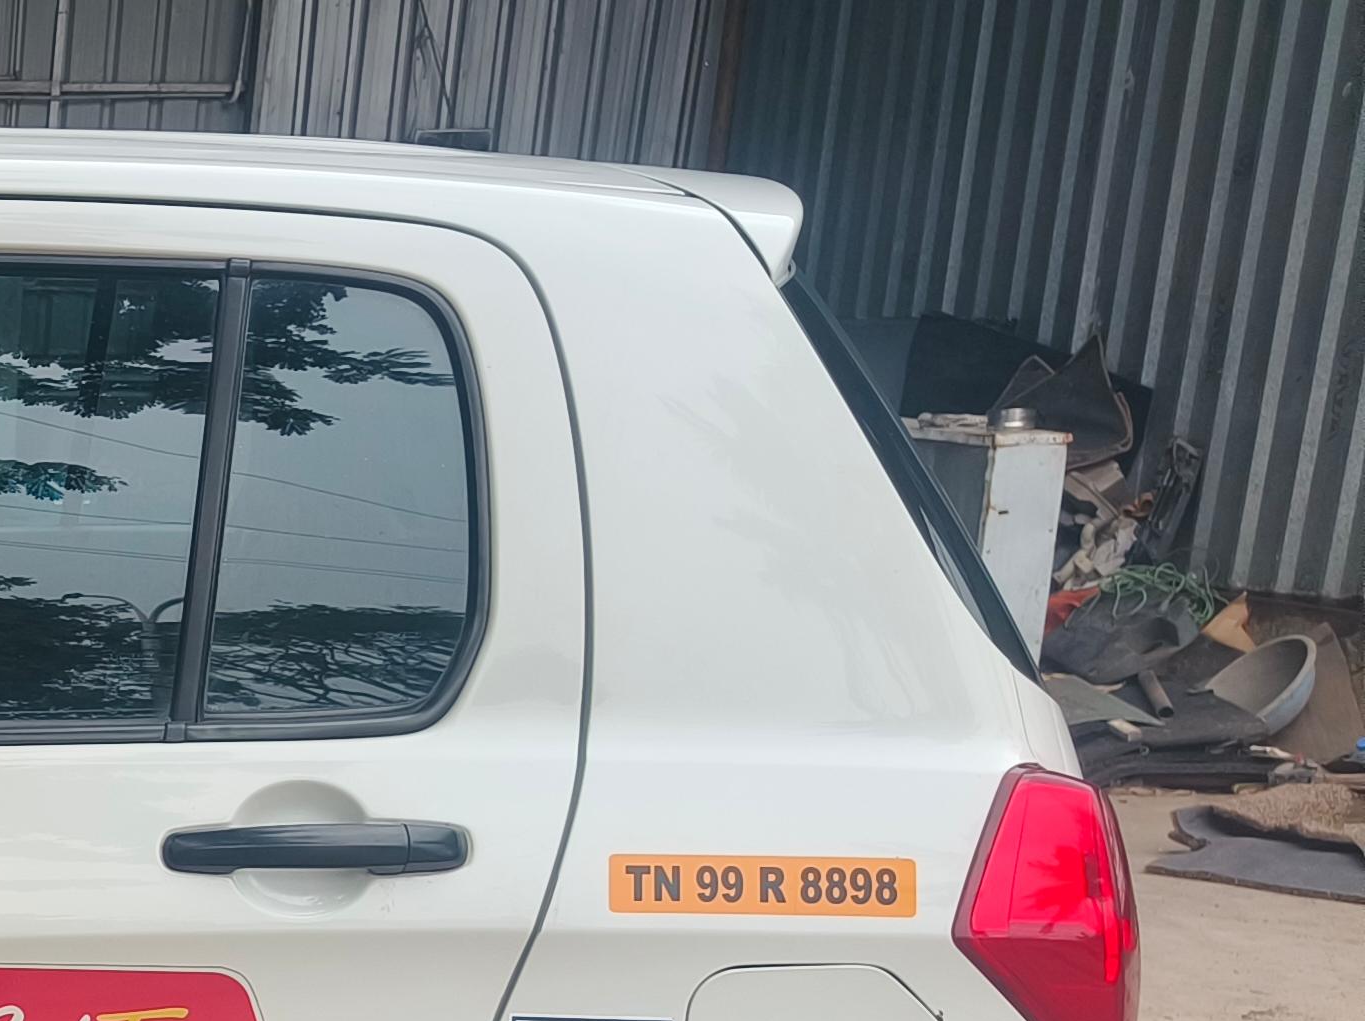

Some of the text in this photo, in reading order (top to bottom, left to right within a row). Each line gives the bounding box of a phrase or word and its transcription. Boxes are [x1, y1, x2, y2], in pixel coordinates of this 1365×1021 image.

[625, 865, 898, 906] TN 99 R 8898
